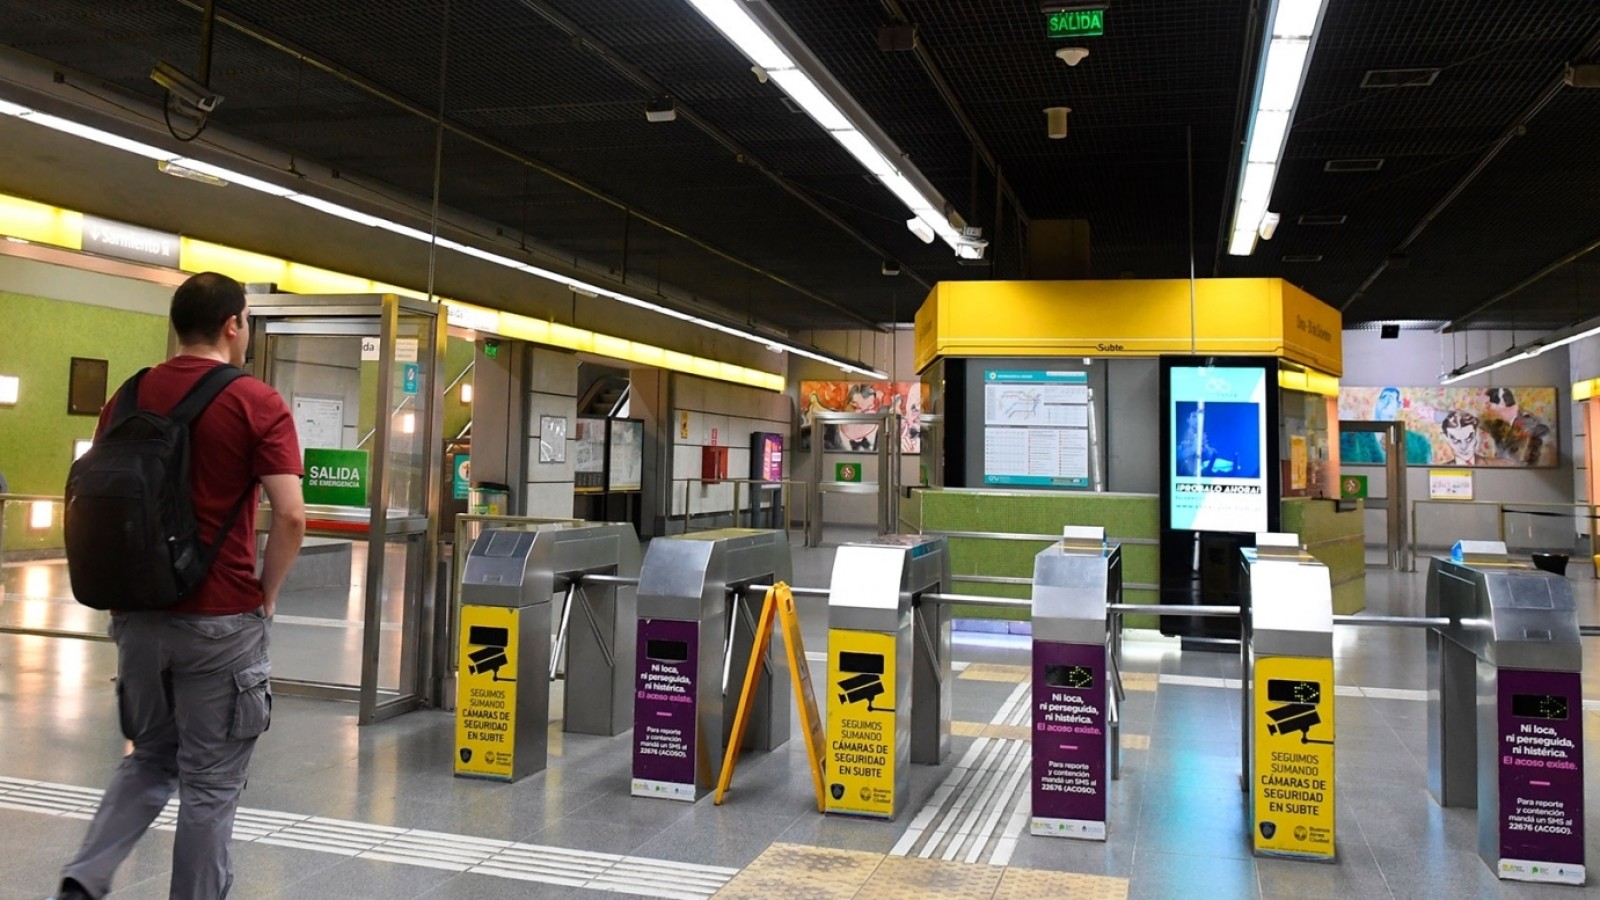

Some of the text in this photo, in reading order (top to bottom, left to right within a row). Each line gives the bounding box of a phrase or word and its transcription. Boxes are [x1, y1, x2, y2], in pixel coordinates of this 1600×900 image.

[1050, 15, 1100, 31] SALIDA
[102, 227, 160, 254] Sarmiento
[310, 466, 360, 480] SALIDA
[320, 480, 360, 488] EMERGENCIA
[662, 665, 679, 674] loca,
[649, 673, 691, 685] perseguida,
[471, 689, 505, 698] SEGUIMOS
[653, 683, 685, 693] histérica.
[646, 693, 668, 701] acoso
[670, 695, 693, 703] existe.
[1063, 694, 1084, 704] loca,
[470, 699, 504, 709] SUMANDO
[1049, 704, 1099, 715] perseguida,
[463, 708, 510, 720] CÁMARAS DE
[1055, 714, 1093, 723] histérica.
[464, 720, 507, 731] SEGURIDAD
[842, 719, 882, 730] SEGUIMOS
[1074, 726, 1101, 734] existe.
[1521, 724, 1557, 736] Ni loca,
[480, 733, 504, 742] SUBTE
[841, 730, 882, 741] SUMANDO
[1506, 734, 1575, 748] ni perseguida,
[833, 739, 888, 754] CÁMARAS DE
[1513, 746, 1567, 758] ni histérica.
[659, 749, 687, 758] (ACOSO).
[835, 753, 885, 765] SEGURIDAD
[1272, 752, 1319, 764] SEGUIMOS
[1504, 756, 1577, 770] El acoso existe.
[840, 766, 882, 777] EN SUBTE
[1272, 763, 1318, 776] SUMANDO
[1262, 774, 1326, 790] CÁMARAS DE
[1064, 785, 1096, 794] (ACOSO).
[1264, 788, 1323, 802] SEGURIDAD
[1270, 802, 1319, 816] EN SUBTE
[1535, 800, 1563, 808] reporte
[1534, 824, 1572, 835] (ACOSO).
